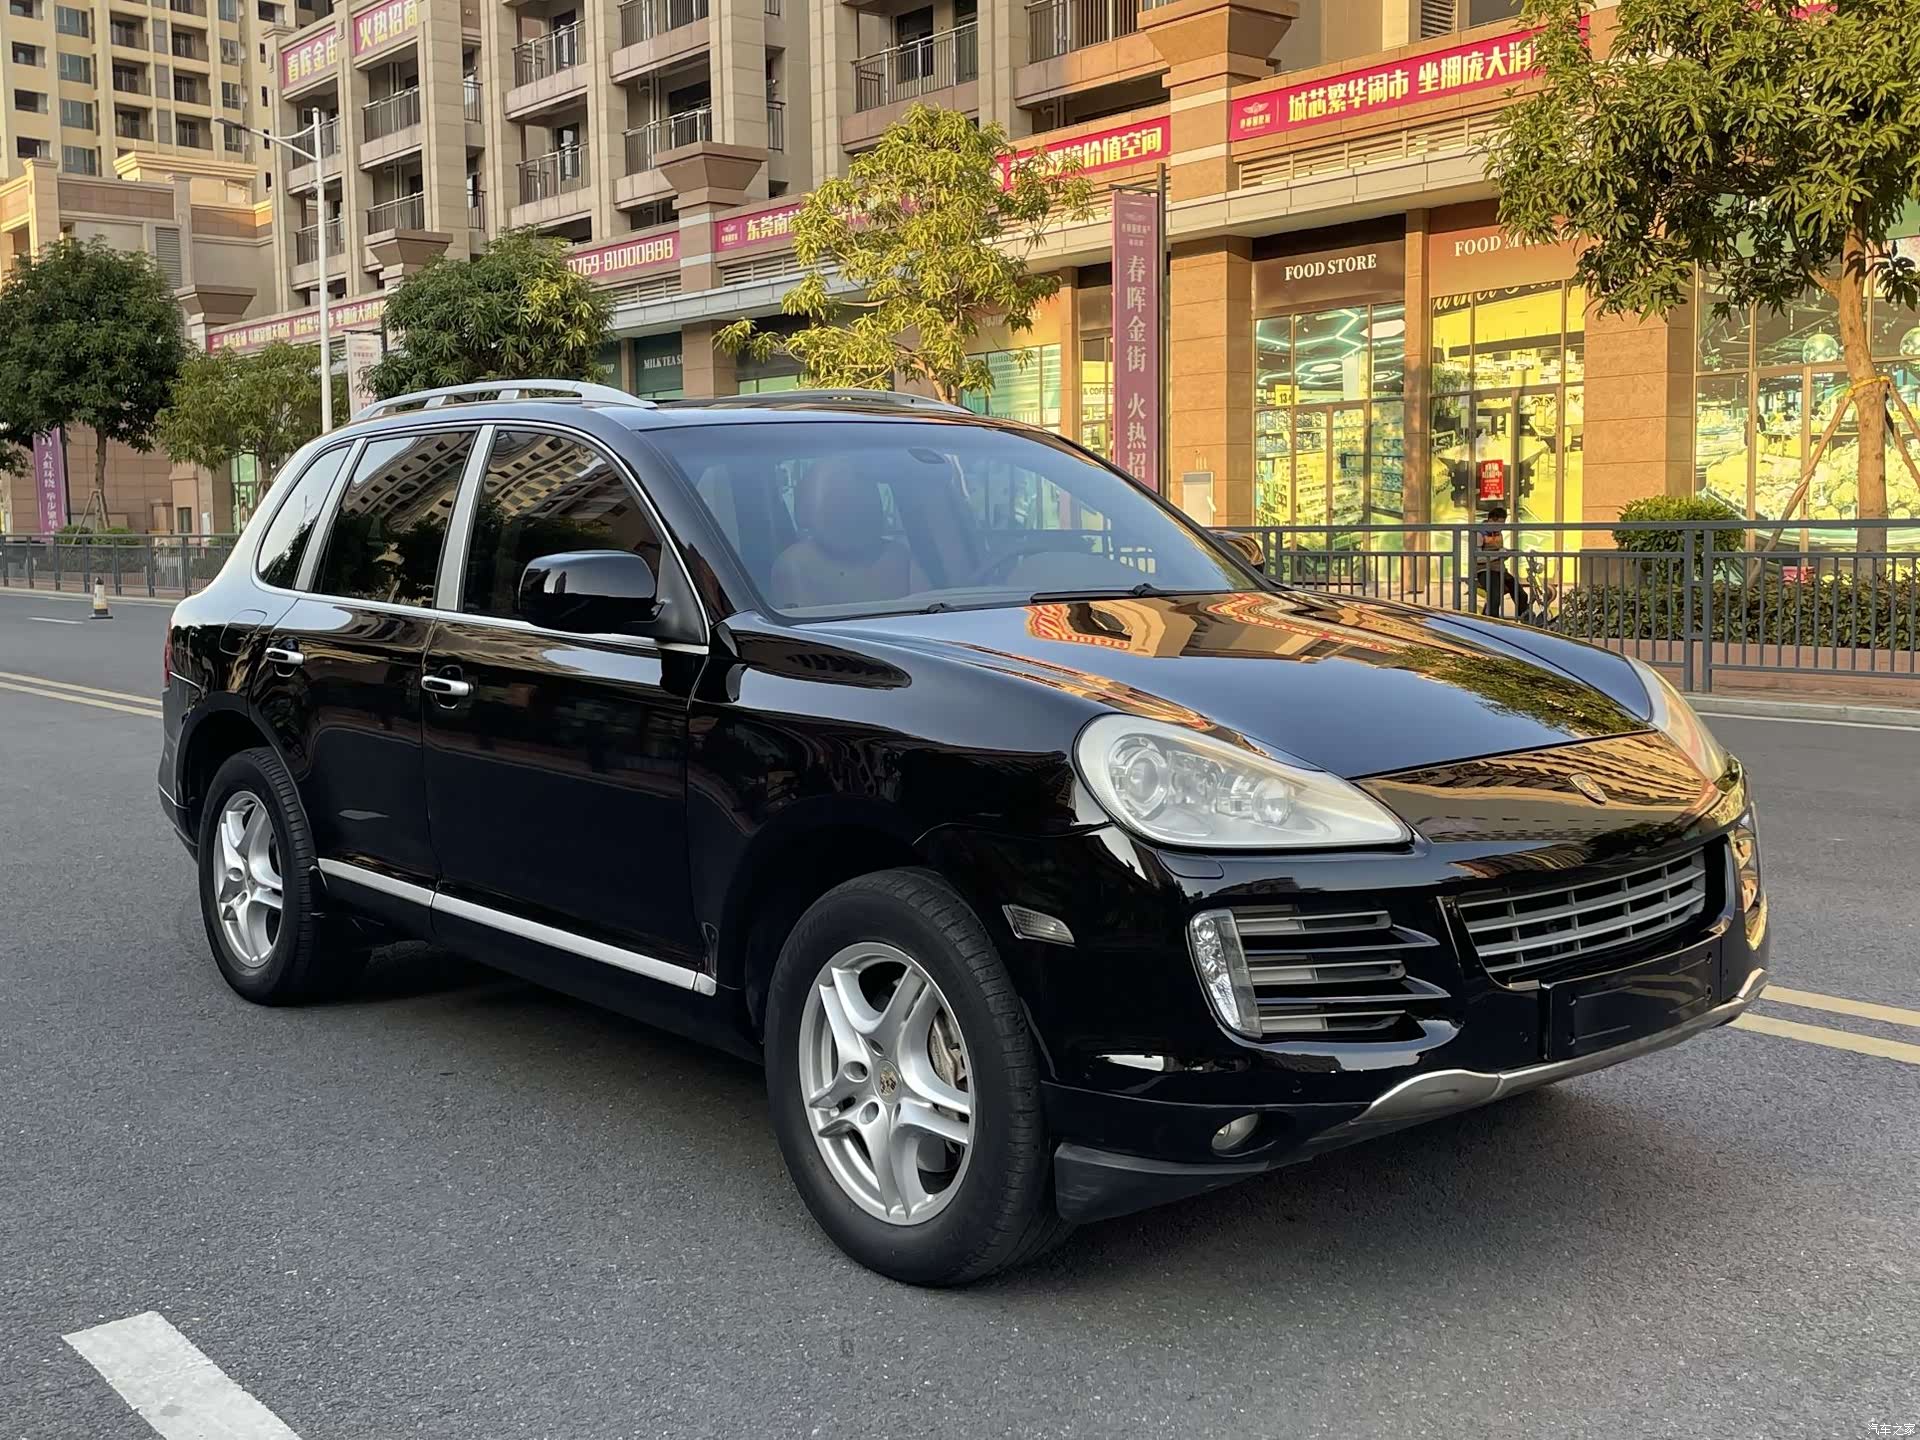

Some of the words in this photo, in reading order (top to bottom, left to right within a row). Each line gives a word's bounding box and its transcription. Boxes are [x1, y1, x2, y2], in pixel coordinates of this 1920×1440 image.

[360, 1, 418, 51] 火热招商
[1288, 69, 1409, 122] 城芯繁华闹市
[1285, 261, 1326, 281] FOOD
[1327, 253, 1377, 275] STORE
[1455, 235, 1502, 257] FOOD
[1126, 255, 1146, 373] 春晖金街
